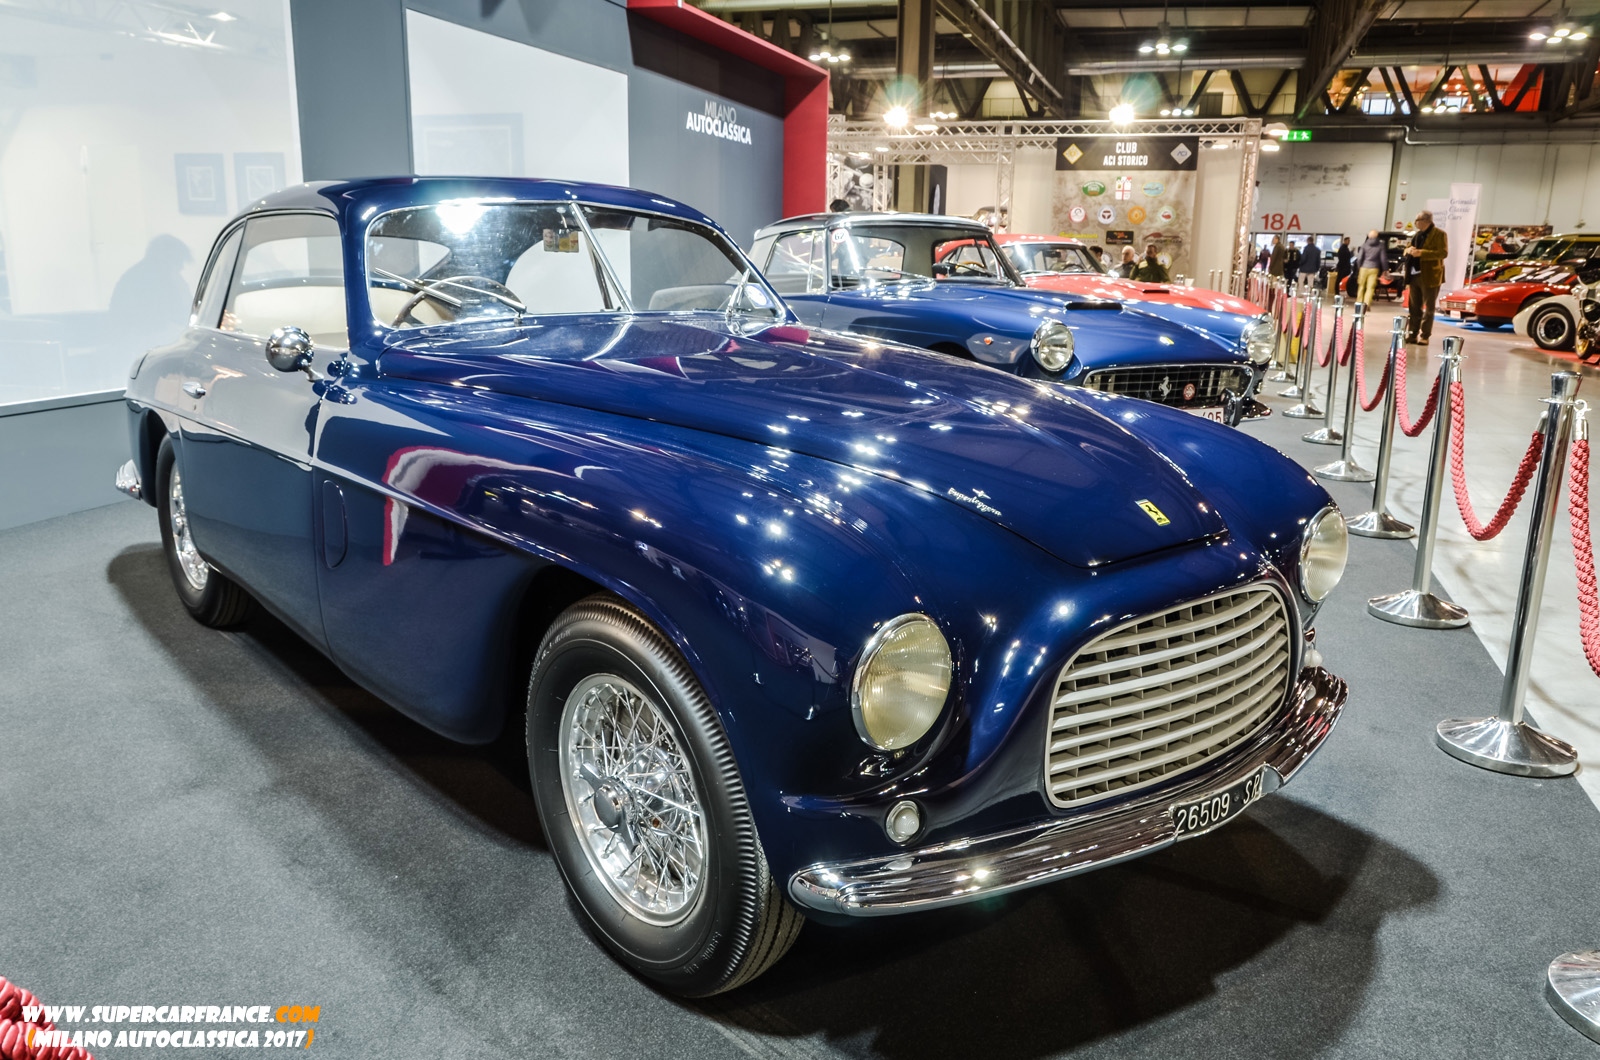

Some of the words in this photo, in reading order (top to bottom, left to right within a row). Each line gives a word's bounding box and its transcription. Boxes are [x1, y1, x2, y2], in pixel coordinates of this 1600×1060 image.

[704, 99, 737, 124] MILANO
[686, 111, 752, 145] AUTOCLASSICA
[1115, 141, 1138, 154] CLUB
[1103, 155, 1116, 166] ACI
[1117, 155, 1149, 166] STORICO
[1260, 213, 1285, 231] 18
[1286, 213, 1302, 231] A
[1175, 793, 1230, 837] 26509
